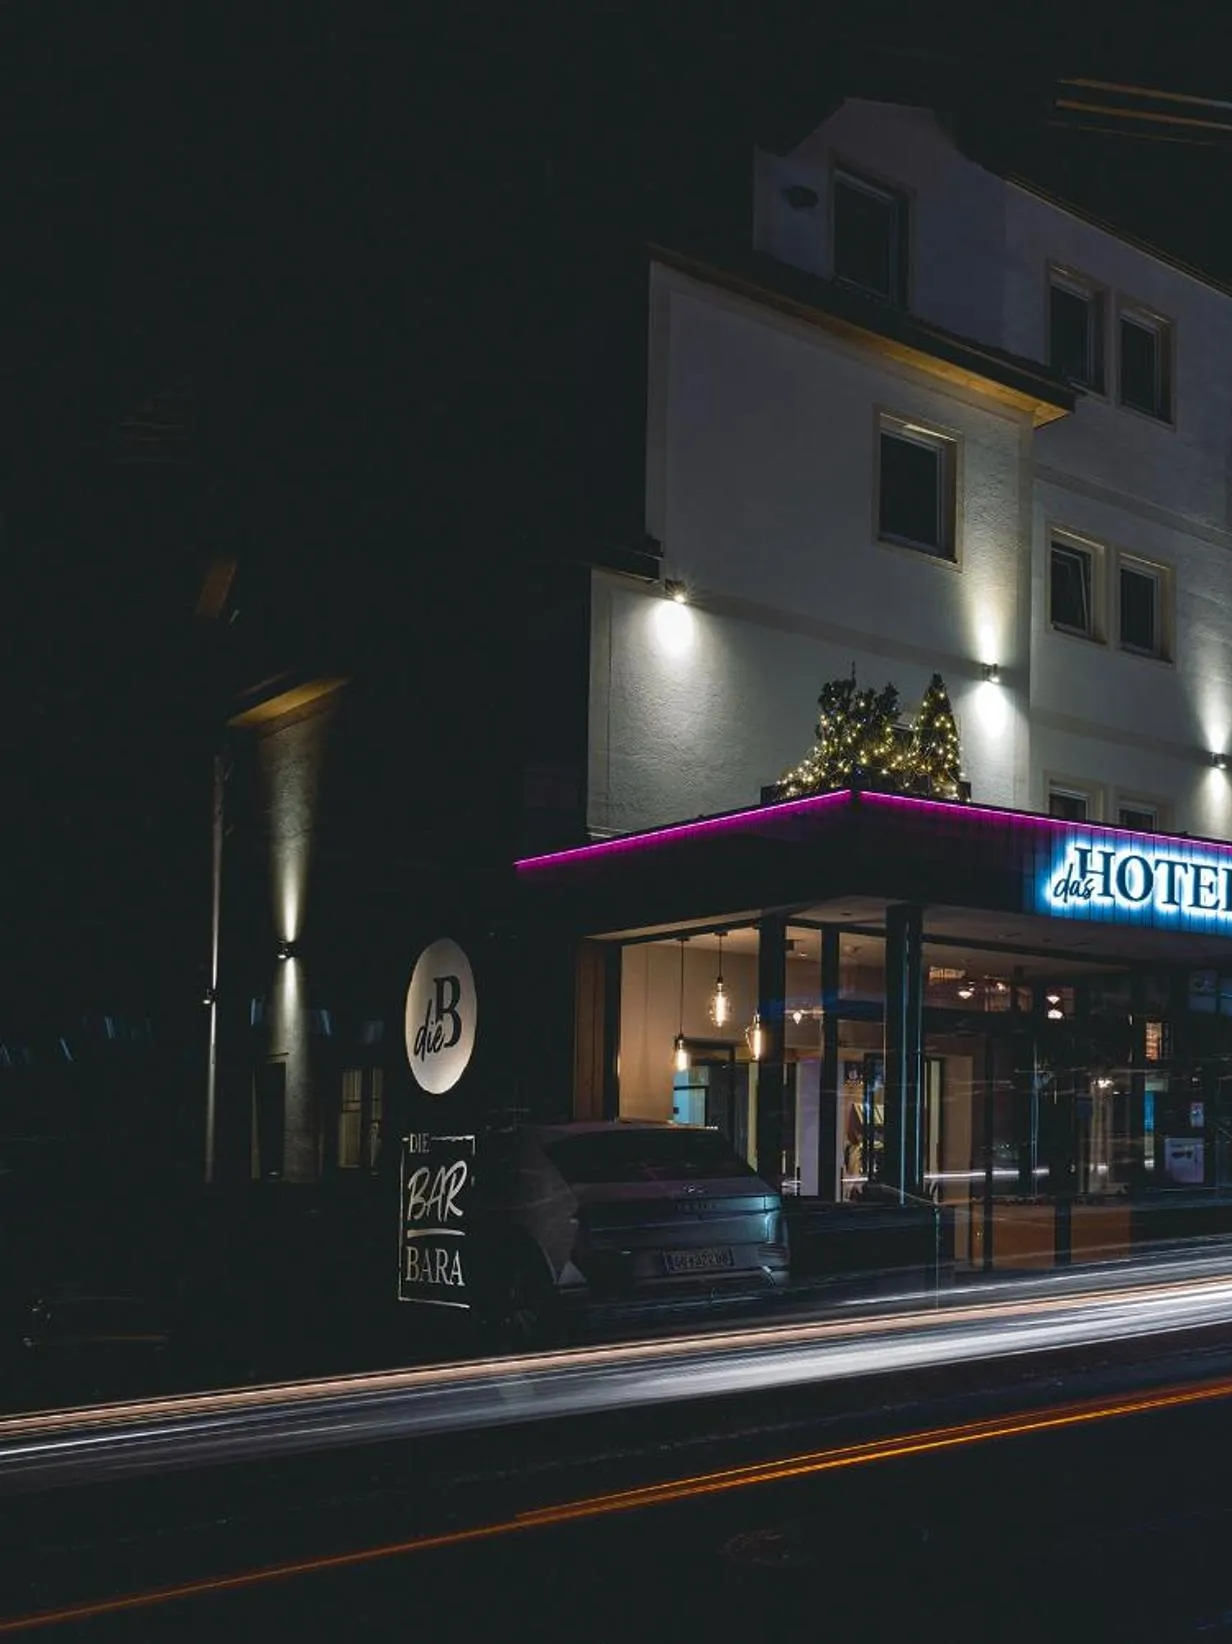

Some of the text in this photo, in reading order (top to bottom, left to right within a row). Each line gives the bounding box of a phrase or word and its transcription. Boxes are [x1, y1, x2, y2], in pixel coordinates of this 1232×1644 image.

[1053, 862, 1096, 904] das
[413, 974, 463, 1063] die B
[409, 1132, 430, 1154] DIE
[406, 1160, 468, 1222] BAR
[405, 1246, 466, 1287] BARA
